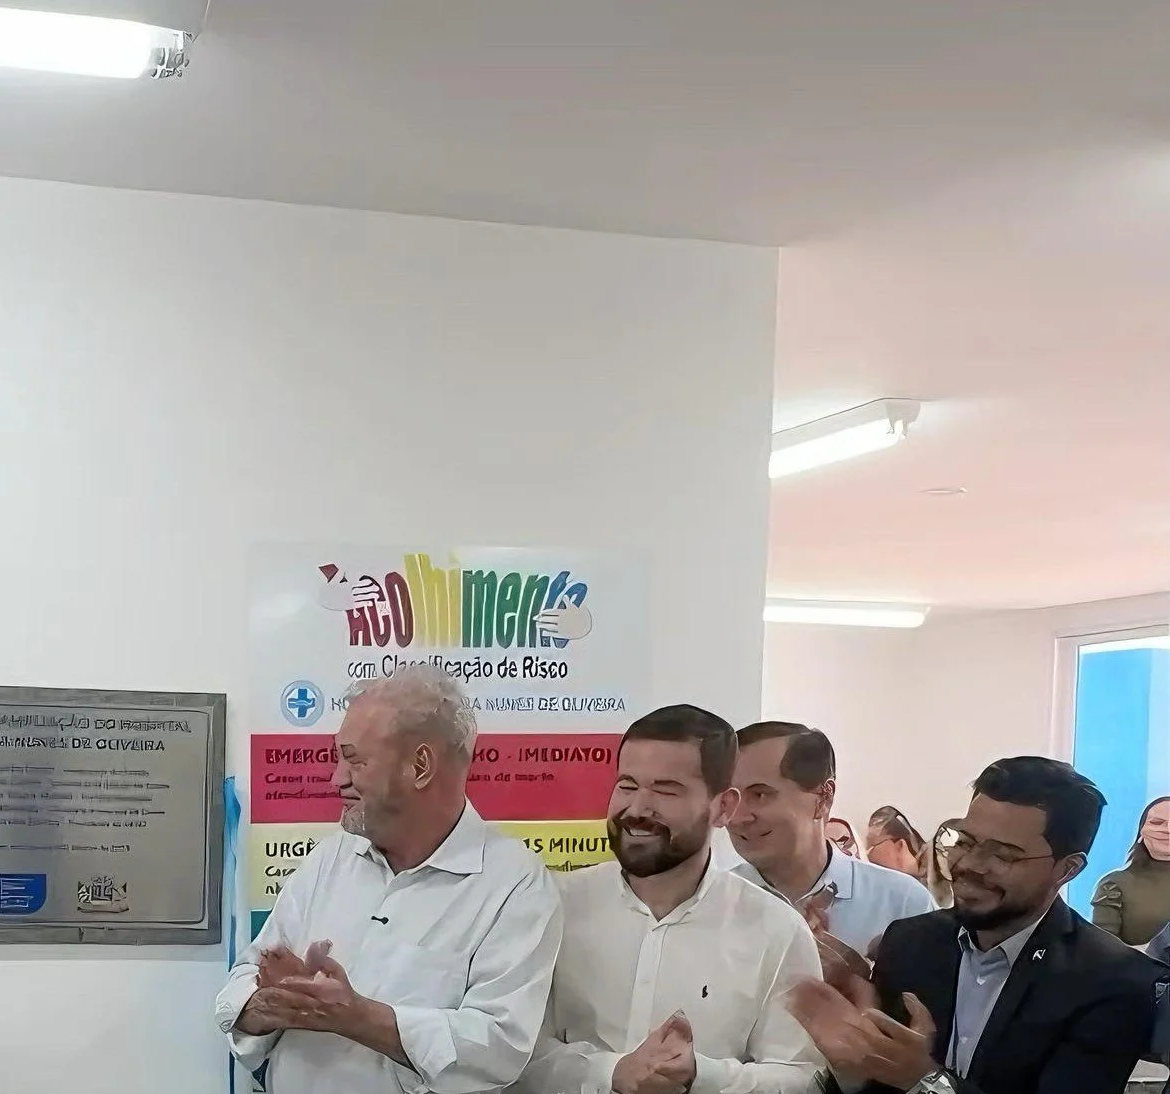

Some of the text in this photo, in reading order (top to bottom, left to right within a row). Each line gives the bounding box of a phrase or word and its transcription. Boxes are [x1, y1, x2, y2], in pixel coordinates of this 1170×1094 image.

[497, 656, 518, 678] de
[522, 656, 568, 679] Risco
[538, 697, 559, 711] DE
[94, 719, 116, 730] DO
